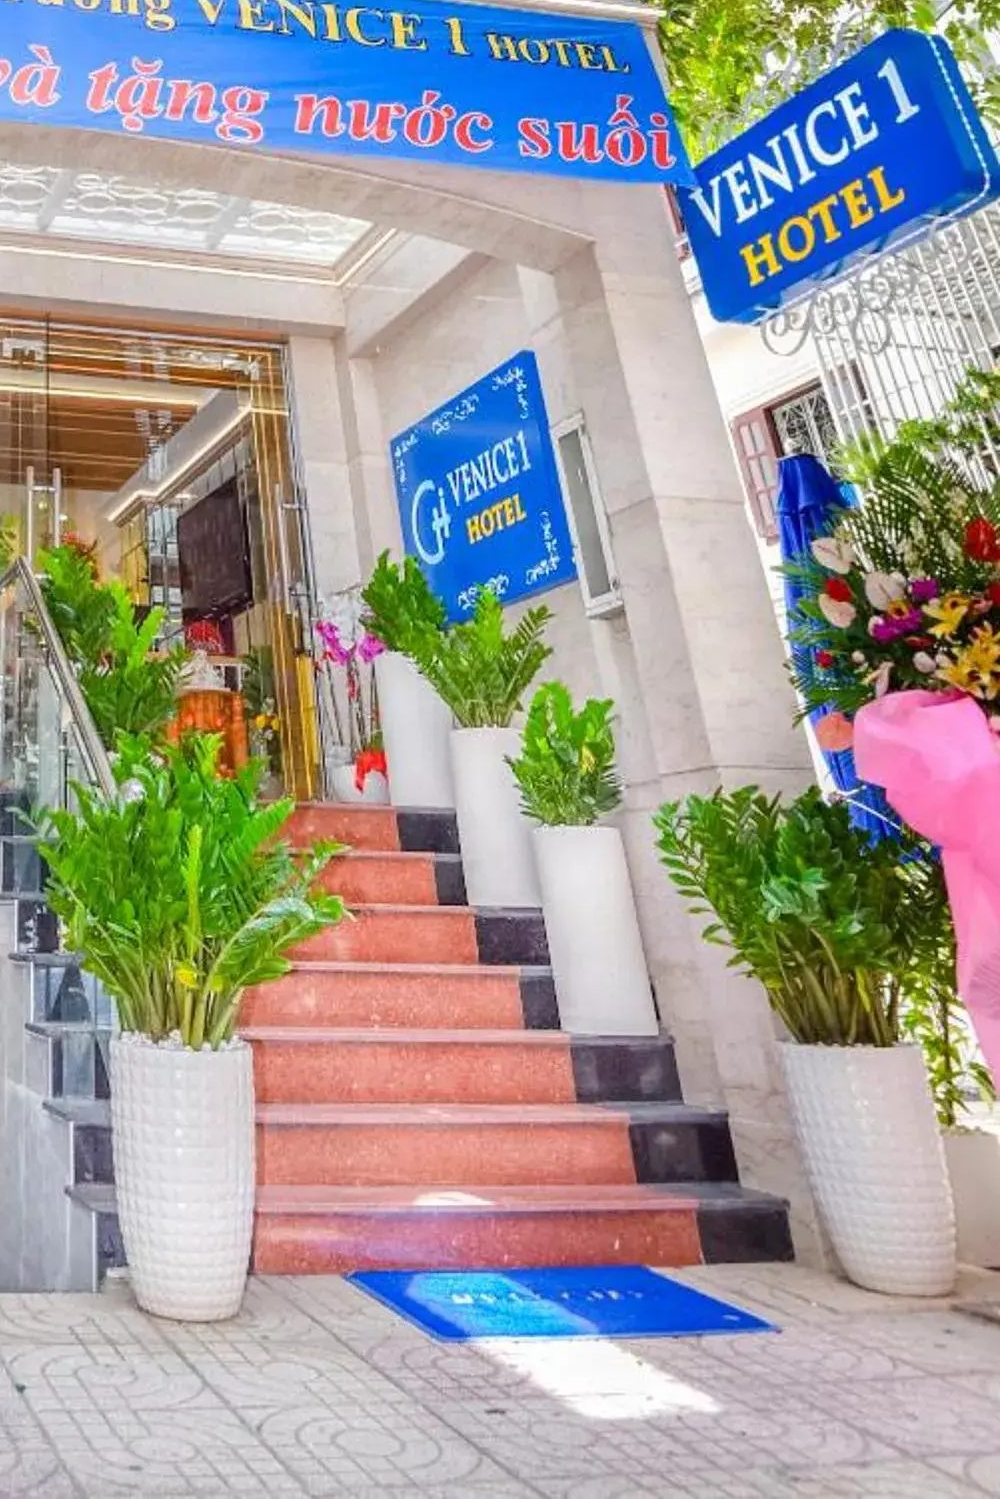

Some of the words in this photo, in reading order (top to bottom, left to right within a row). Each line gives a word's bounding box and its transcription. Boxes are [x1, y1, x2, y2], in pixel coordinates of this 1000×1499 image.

[444, 17, 473, 57] 1
[486, 31, 633, 74] HOTEL
[85, 56, 269, 143] tặng
[292, 90, 495, 153] nước
[517, 94, 678, 170] suối
[689, 81, 881, 238] VENICE
[876, 57, 920, 124] 1
[739, 166, 905, 287] HOTEL
[465, 493, 527, 545] HOTEL
